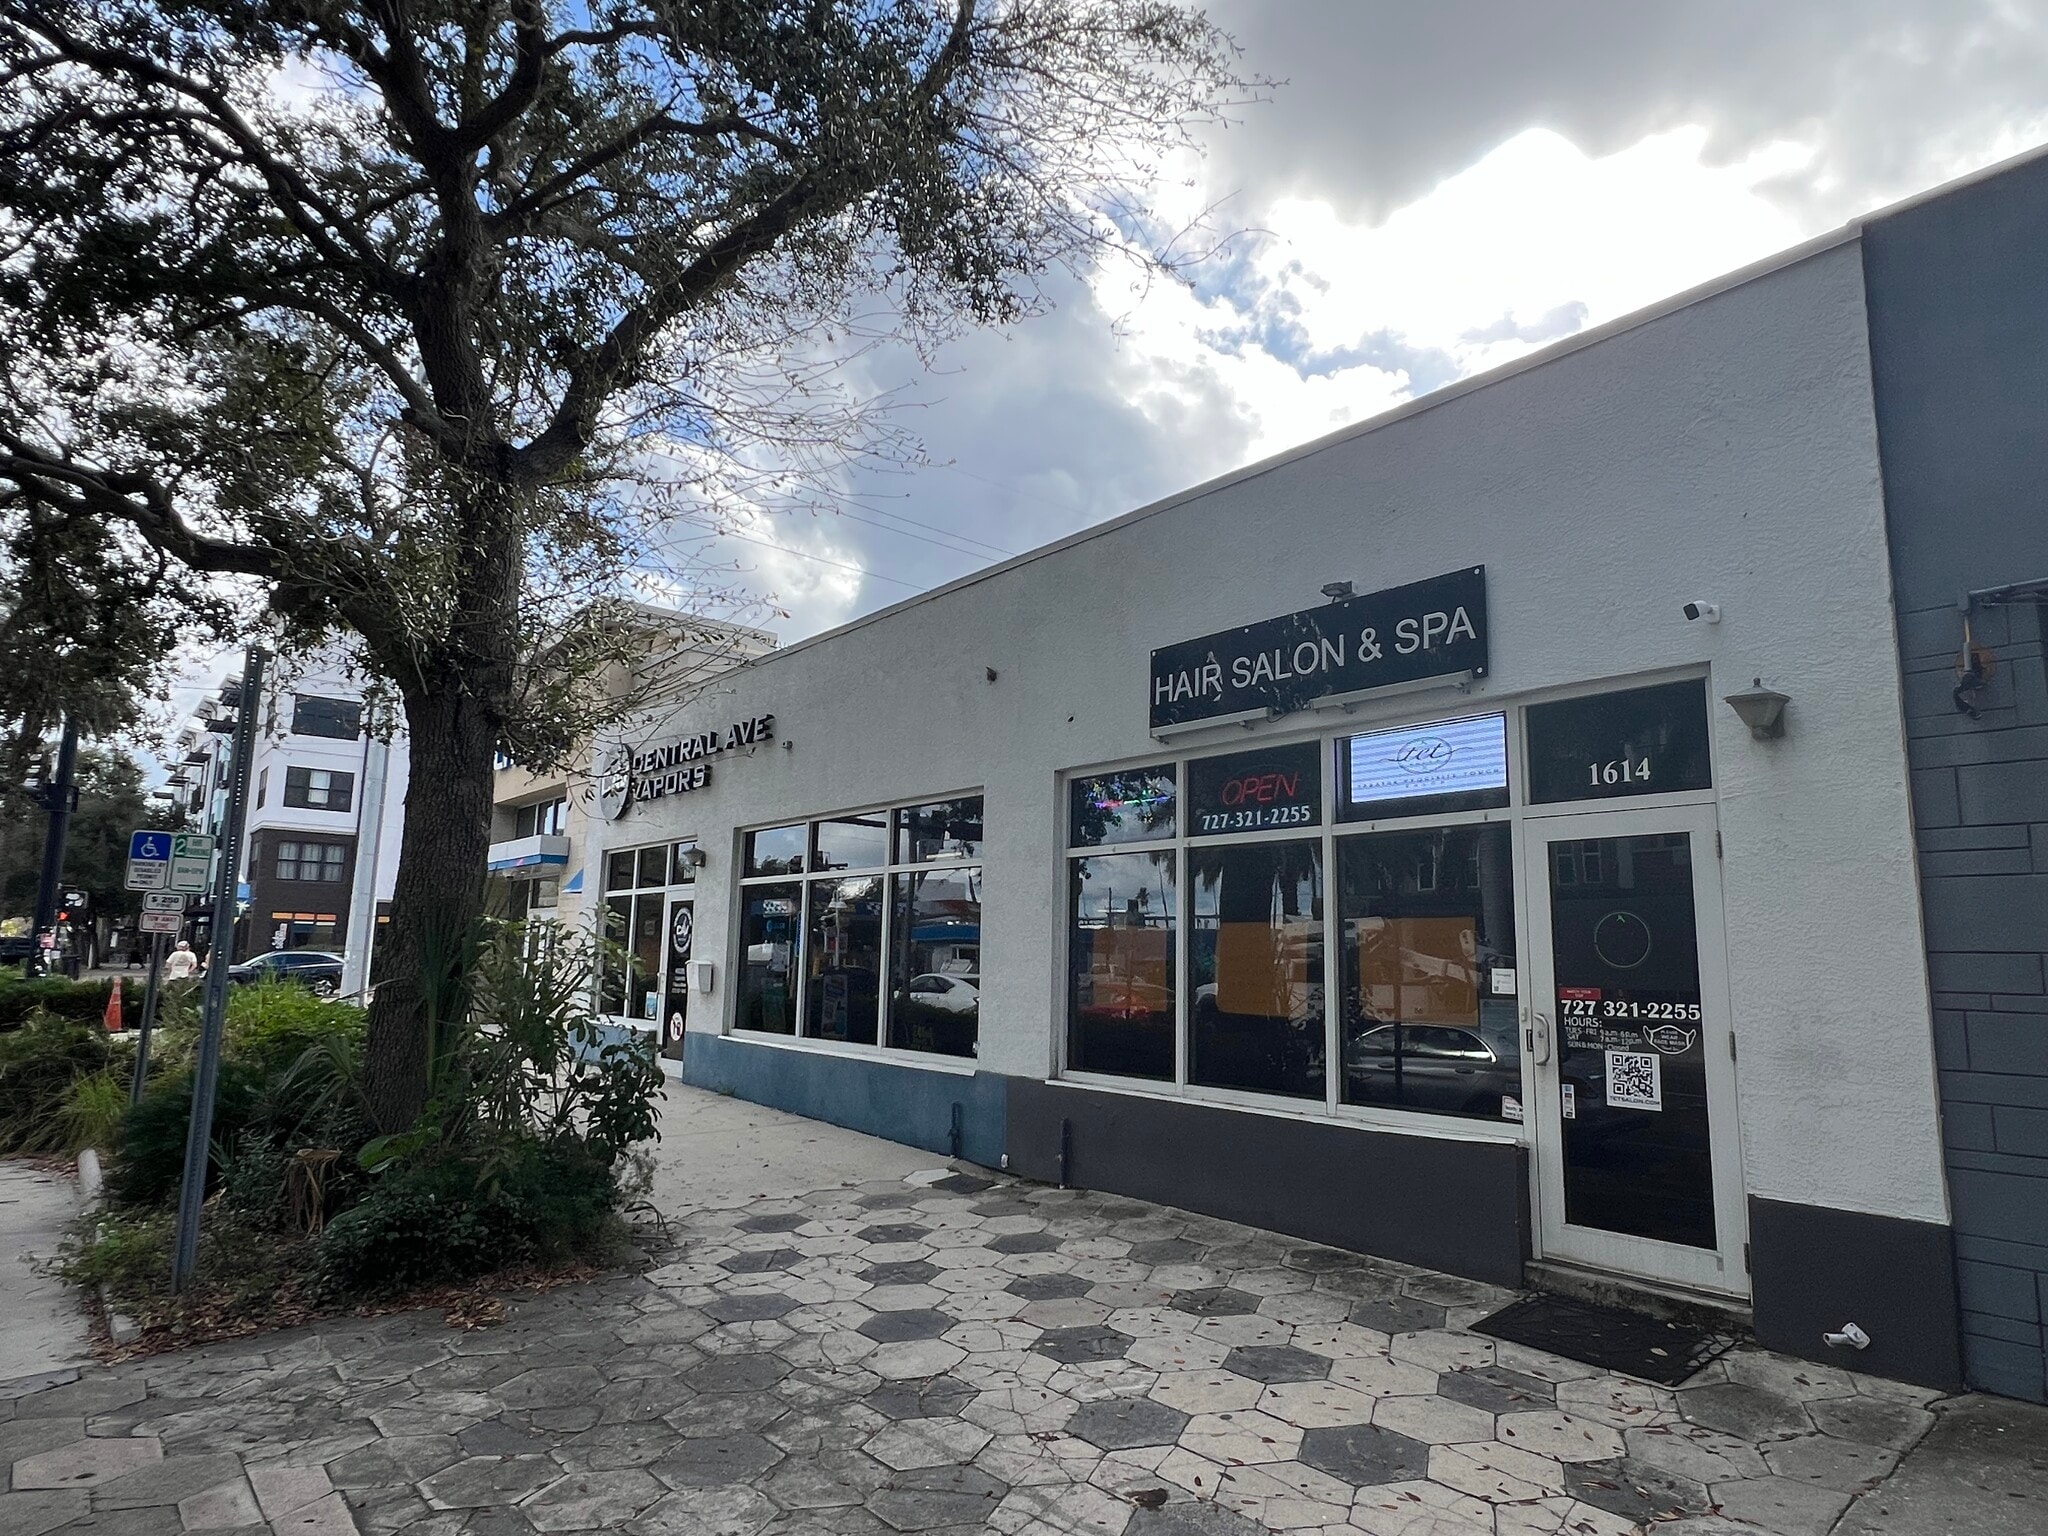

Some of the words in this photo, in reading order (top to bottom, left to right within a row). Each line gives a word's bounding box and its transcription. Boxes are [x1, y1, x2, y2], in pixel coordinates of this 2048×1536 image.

[1155, 664, 1222, 705] HAIR
[1231, 634, 1345, 689] SALON
[1358, 627, 1383, 662] &
[1395, 606, 1476, 654] SPA
[632, 731, 722, 774] CENTRAL
[725, 714, 775, 749] AVE
[632, 764, 711, 801] VAPORS
[1588, 757, 1651, 786] 1614
[1221, 773, 1300, 806] OPEN
[1202, 805, 1311, 830] 727-321-2255
[1561, 1000, 1596, 1015] 727
[1603, 1001, 1701, 1020] 321-2255
[1564, 1016, 1602, 1028] HOURS:
